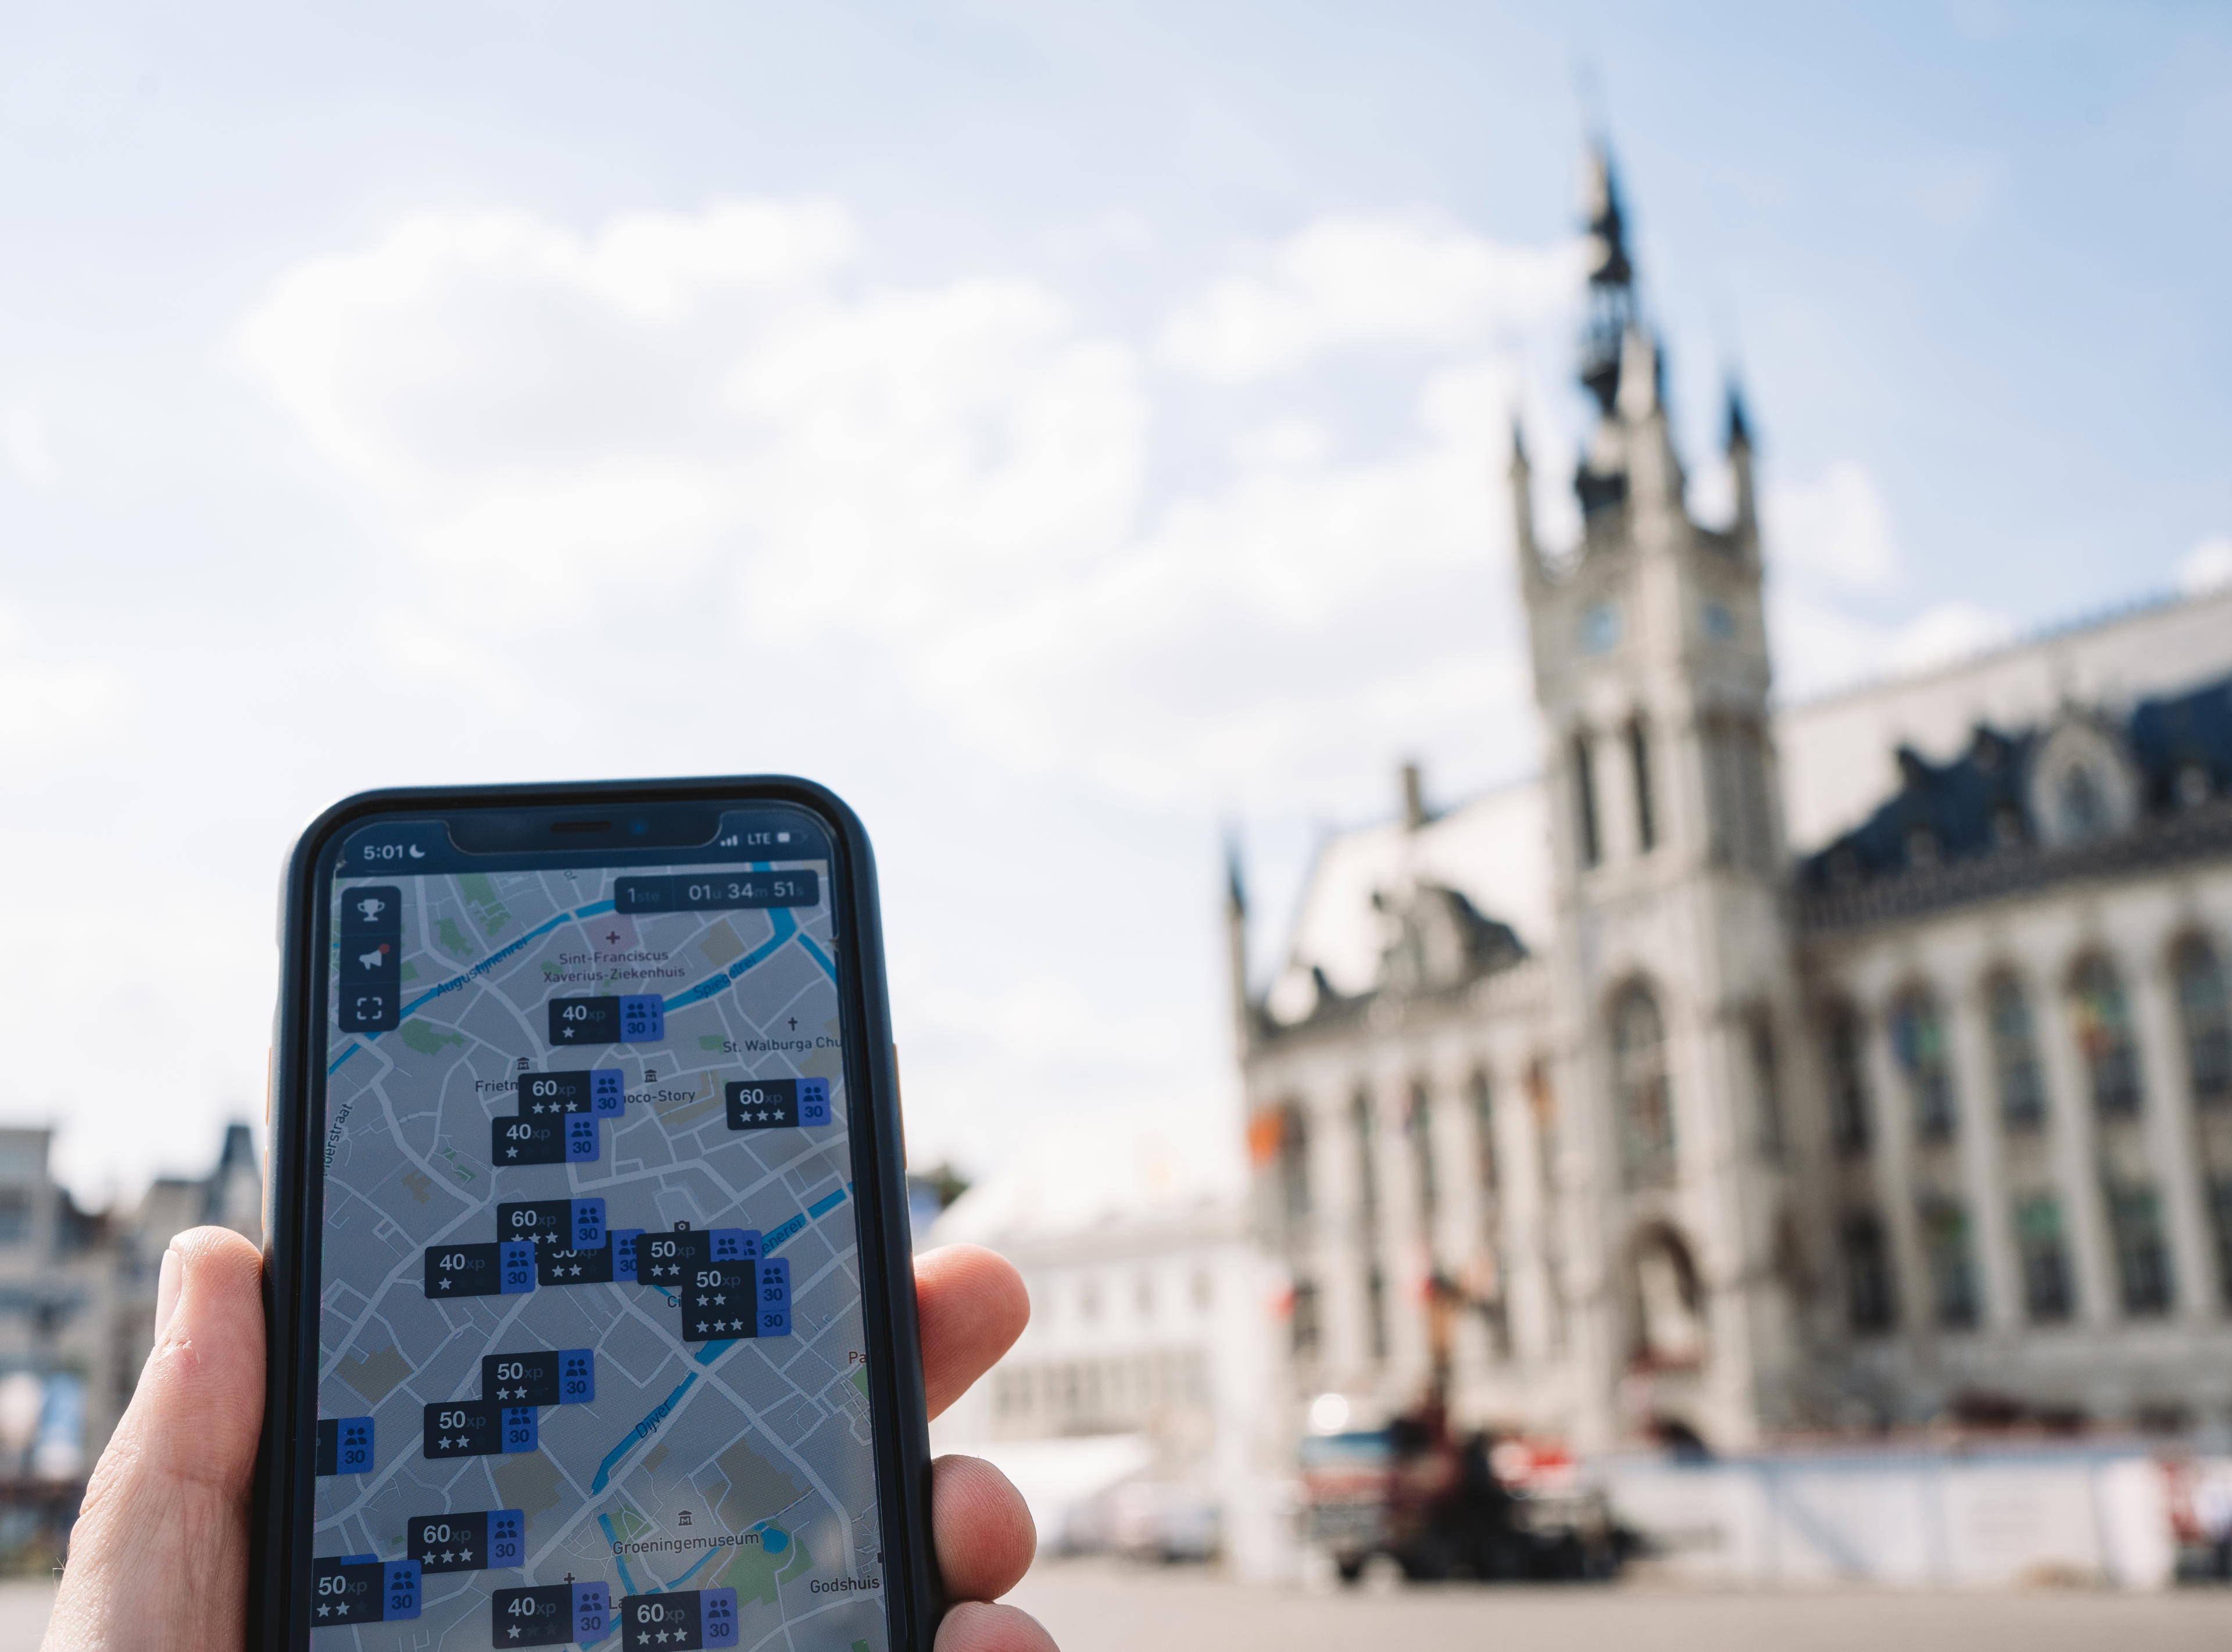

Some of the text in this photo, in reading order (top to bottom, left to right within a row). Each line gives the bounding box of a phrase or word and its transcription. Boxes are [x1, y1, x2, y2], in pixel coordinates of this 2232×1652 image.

[747, 833, 771, 845] LTE
[363, 844, 404, 860] 5:01
[559, 950, 669, 965] Sint-Franciscus
[437, 936, 528, 997] Augustijnenrei
[543, 965, 686, 983] Xaverius-Ziekenhuis
[627, 1022, 646, 1035] 30
[723, 1040, 741, 1053] St.
[745, 1038, 812, 1053] Walburga
[598, 1097, 616, 1110] 30
[804, 1106, 824, 1118] 30
[573, 1141, 591, 1153] 30
[579, 1228, 598, 1240] 30
[507, 1271, 527, 1285] 30
[763, 1288, 783, 1301] 30
[763, 1314, 783, 1327] 30
[566, 1381, 586, 1394] 30
[635, 1400, 671, 1439] Dijver
[509, 1429, 530, 1443] 30
[345, 1450, 365, 1464] 30
[495, 1543, 515, 1558] 30
[613, 1533, 760, 1556] Groeningemuseum
[810, 1576, 880, 1594] Godshuis
[391, 1595, 412, 1610] 30
[581, 1616, 601, 1631] 30
[710, 1622, 730, 1637] 30
